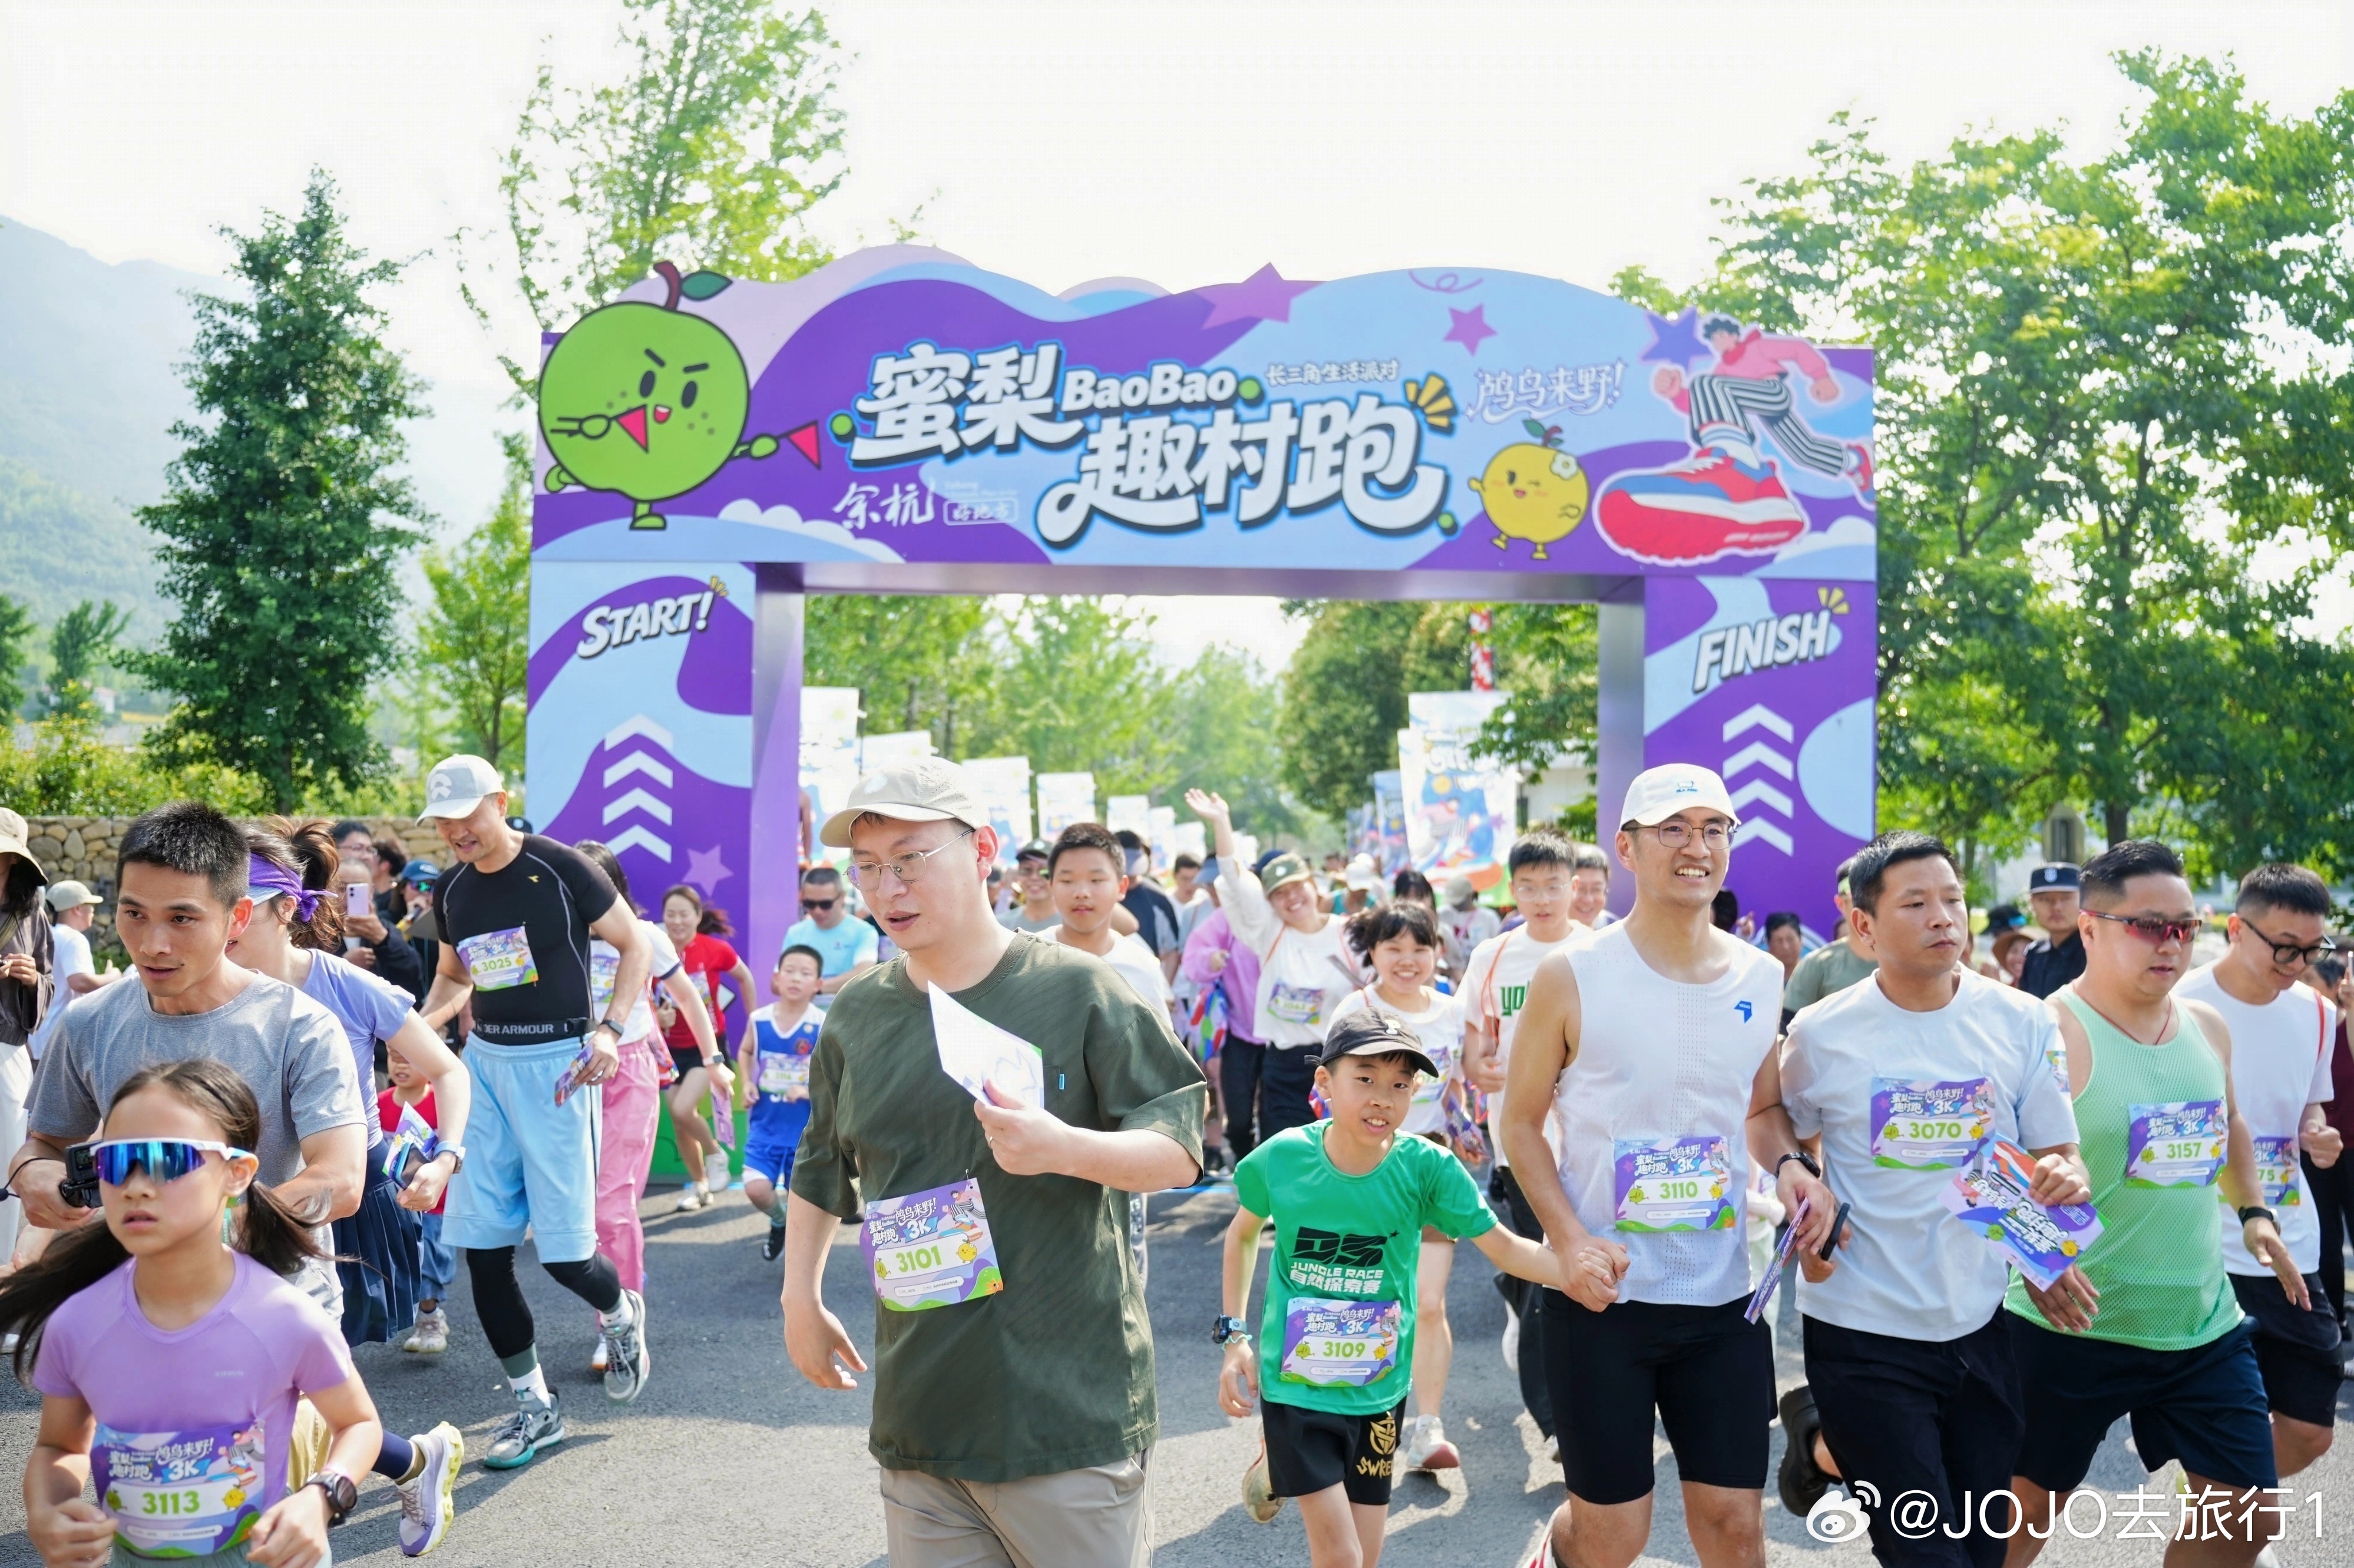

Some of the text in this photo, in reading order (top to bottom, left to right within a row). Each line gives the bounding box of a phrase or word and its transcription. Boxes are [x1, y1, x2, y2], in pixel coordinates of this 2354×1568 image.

[1266, 359, 1399, 387] 长三角生活派对
[852, 342, 1238, 462] 蜜梨 BaoBao
[1037, 394, 1444, 543] 趣村跑
[832, 478, 935, 530] 余杭
[576, 591, 715, 659] START!
[1694, 610, 1831, 692] FINISH
[482, 957, 511, 971] 3025
[502, 1023, 554, 1034] ARMOUR
[1933, 1100, 1955, 1114] 3K
[1909, 1122, 1962, 1139] 3070
[2183, 1120, 2200, 1136] 3K
[2167, 1142, 2202, 1159] 3157
[1677, 1159, 1695, 1173] 3K
[2257, 1169, 2274, 1182] 75
[1659, 1182, 1698, 1199] 3110
[895, 1196, 937, 1225] 鸬鸟来野!
[869, 1219, 885, 1234] 蜜梨
[907, 1218, 931, 1239] 3K
[872, 1228, 899, 1246] 趣村跑
[1289, 1226, 1388, 1268] DS
[896, 1245, 942, 1272] 3101
[1291, 1262, 1384, 1279] JUNGLE RACE
[1290, 1269, 1382, 1294] 自然探索赛
[1347, 1321, 1365, 1334] 3K
[1323, 1341, 1366, 1357] 3109
[168, 1458, 200, 1481] 3K
[1357, 1456, 1393, 1479] SWRE
[142, 1491, 200, 1514] 3113
